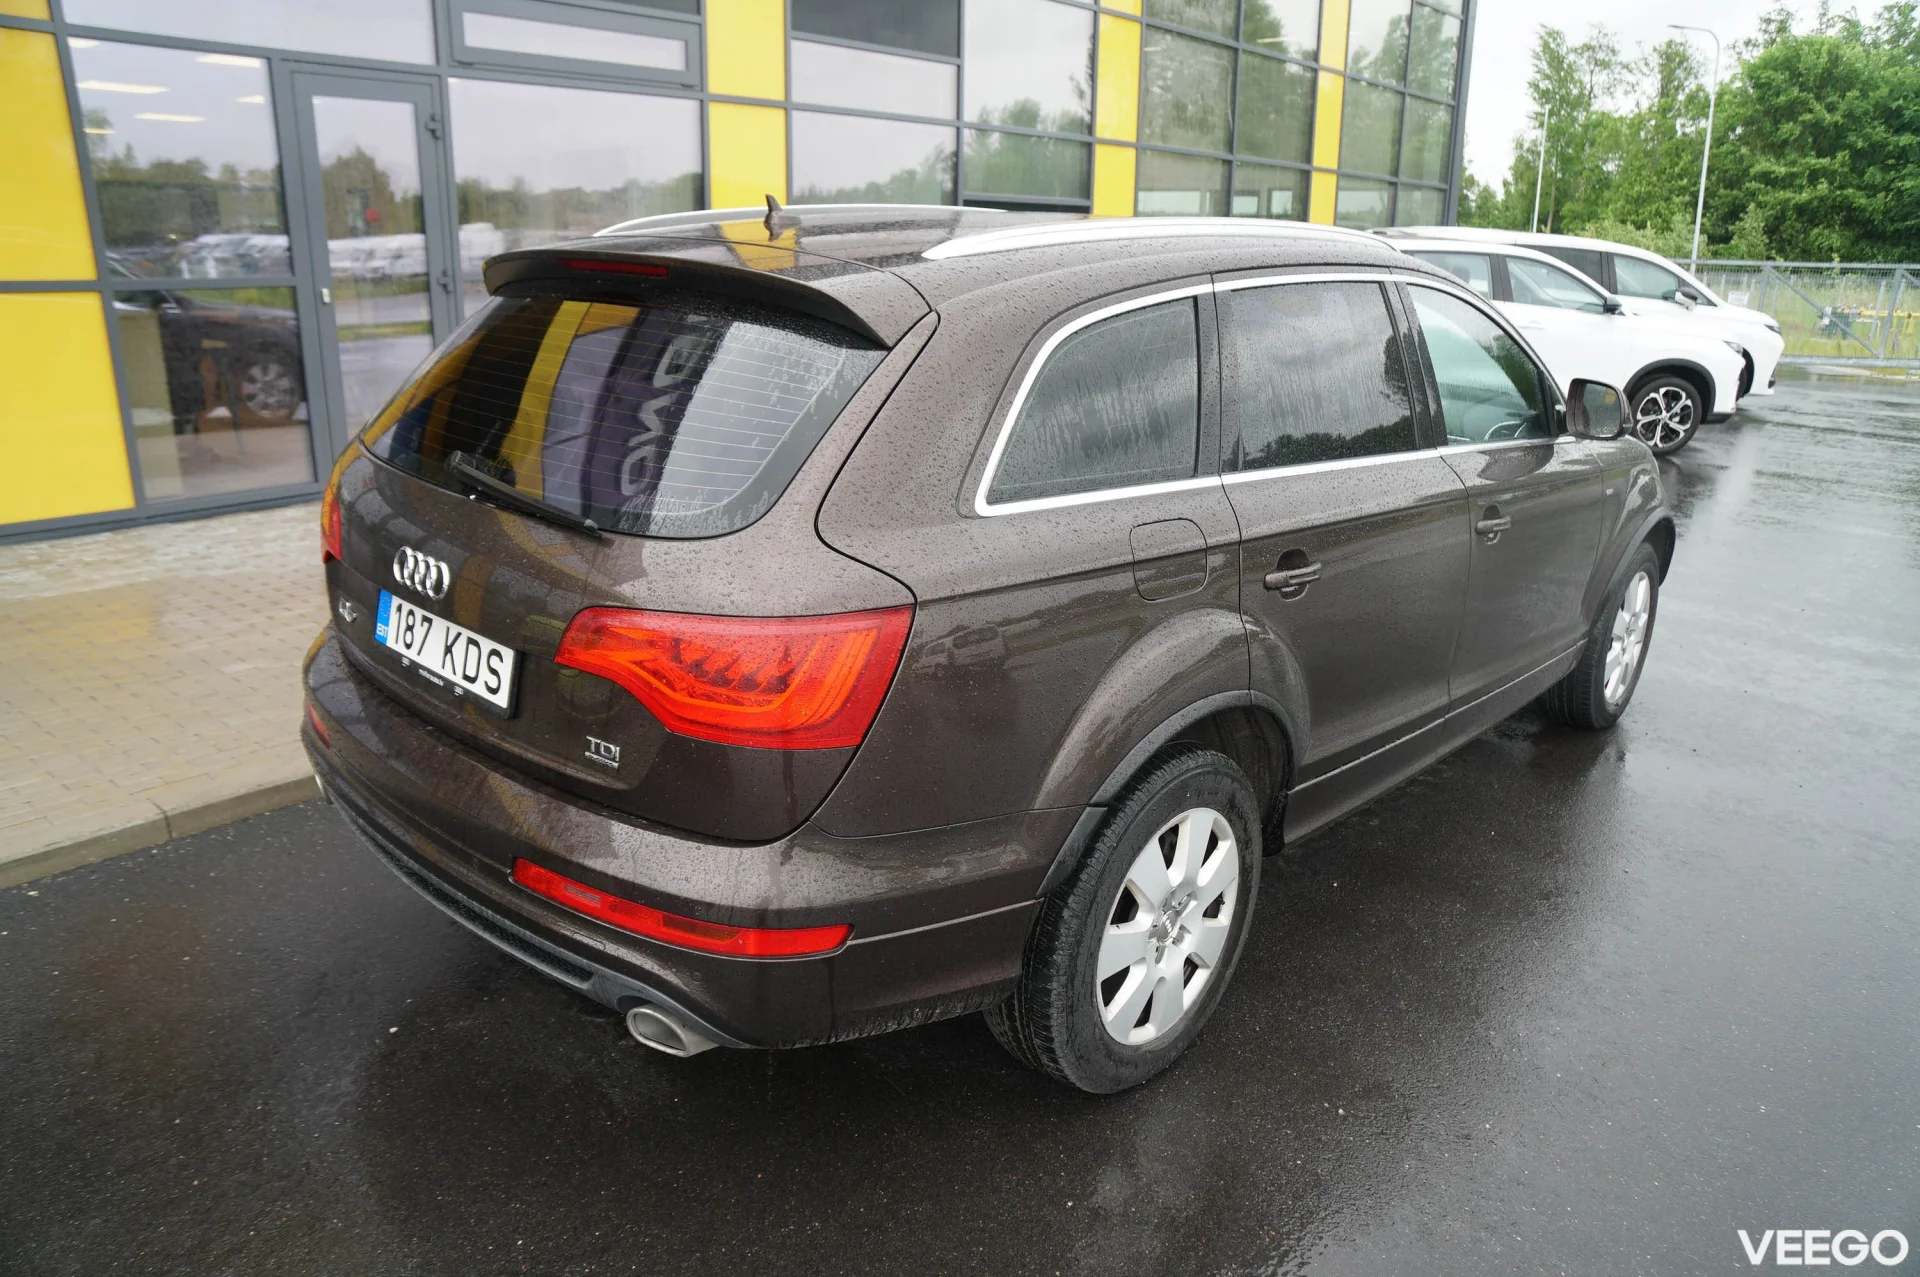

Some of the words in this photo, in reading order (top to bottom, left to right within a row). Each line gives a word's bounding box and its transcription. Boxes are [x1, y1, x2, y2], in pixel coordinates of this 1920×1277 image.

[376, 622, 389, 638] EST
[395, 602, 434, 656] 187
[441, 625, 504, 696] KDS
[585, 735, 620, 762] TDI
